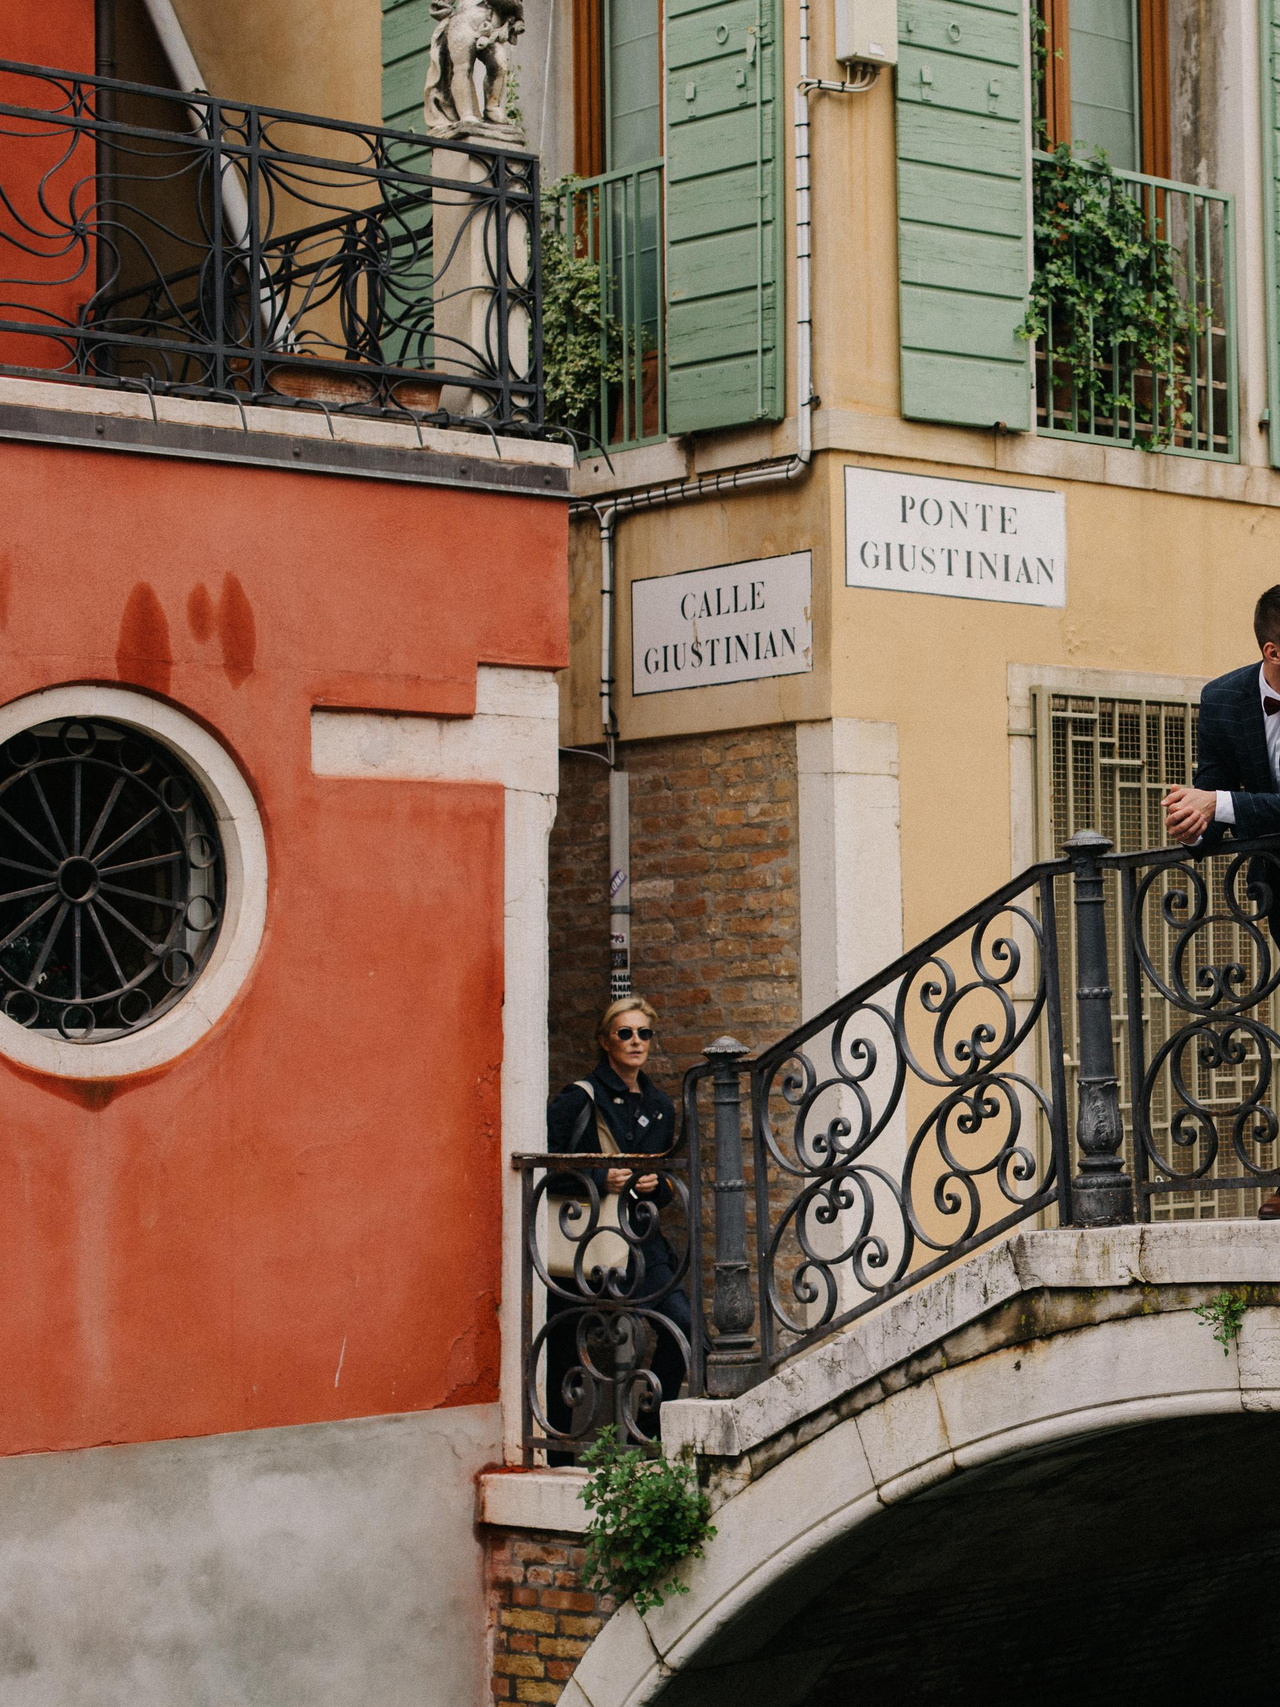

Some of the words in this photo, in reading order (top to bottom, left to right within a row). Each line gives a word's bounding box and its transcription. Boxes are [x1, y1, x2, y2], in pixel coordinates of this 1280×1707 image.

[899, 494, 1019, 536] PONTE
[859, 540, 1056, 586] GIUSTINIAN
[680, 580, 766, 621] CALLE
[643, 626, 797, 676] GIUSTINIAN
